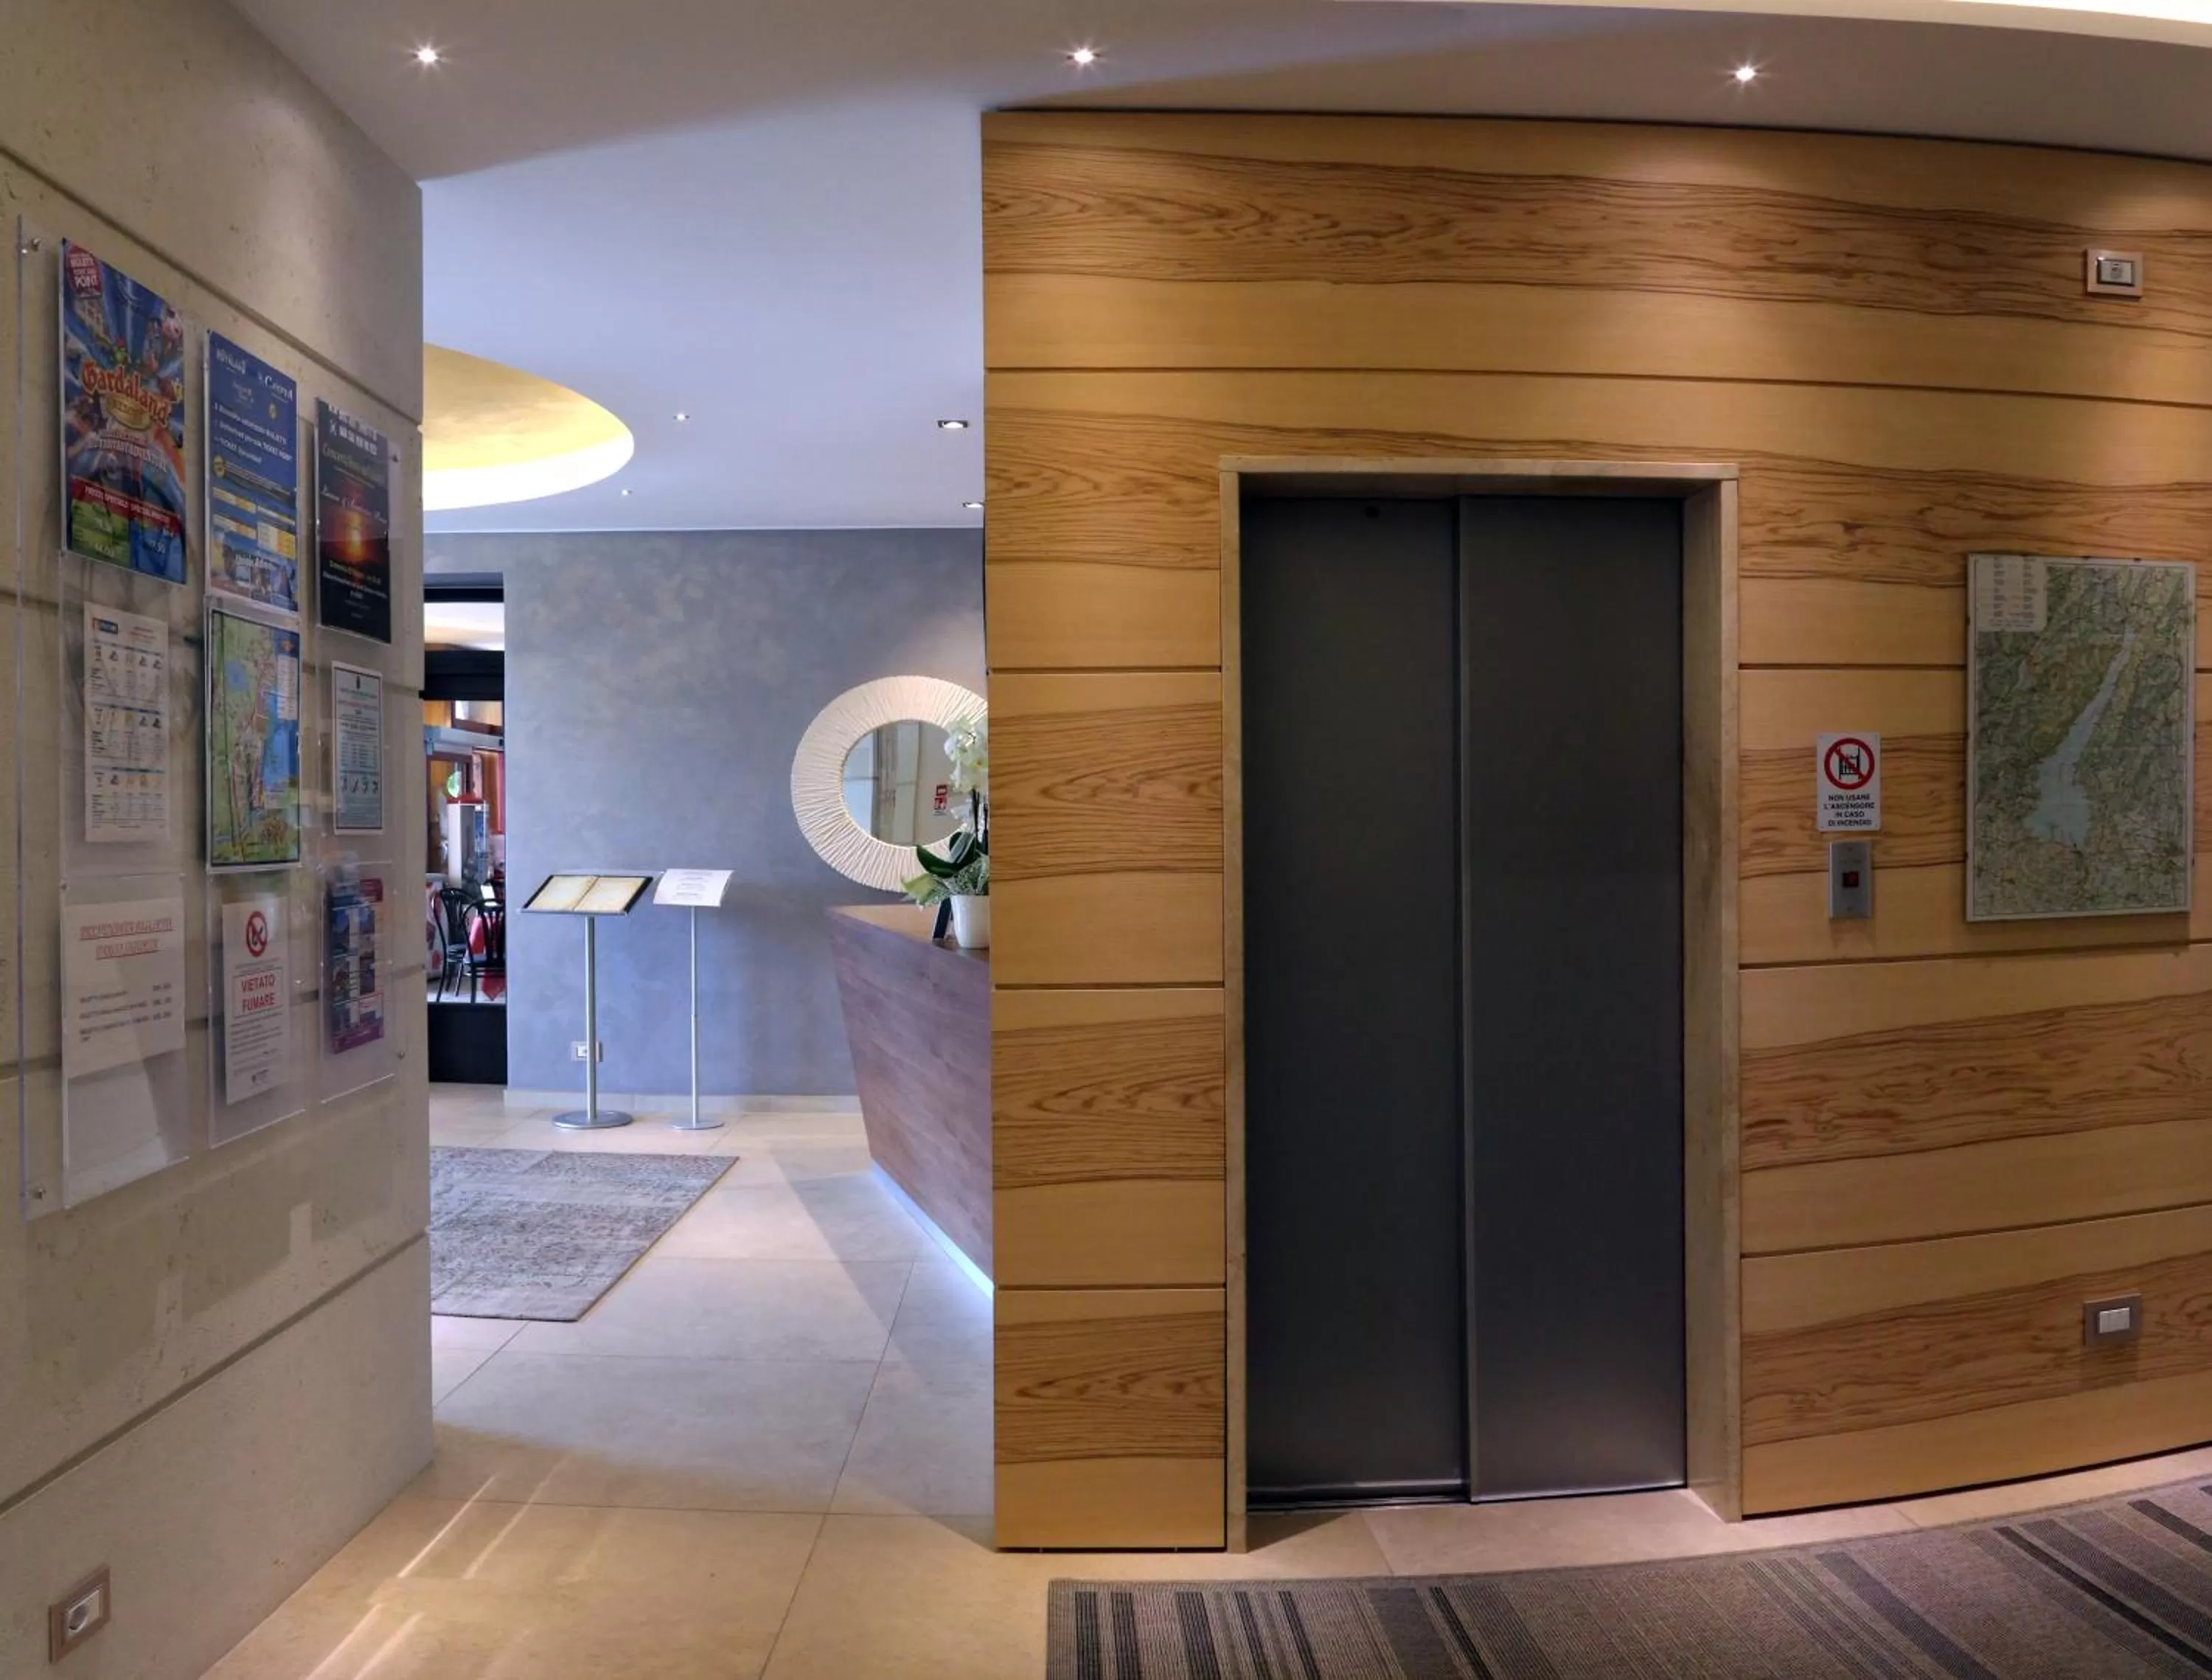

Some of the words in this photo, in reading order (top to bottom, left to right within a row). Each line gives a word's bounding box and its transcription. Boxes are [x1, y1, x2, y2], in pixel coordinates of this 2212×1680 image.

[82, 361, 171, 427] Gardaland
[1828, 794, 1844, 802] NON
[1846, 793, 1871, 801] USARE
[1823, 802, 1875, 810] L'ASCENSORE
[1837, 819, 1872, 827] INCENDIO
[241, 973, 275, 992] VIETATO
[242, 992, 275, 1013] FUMARE
